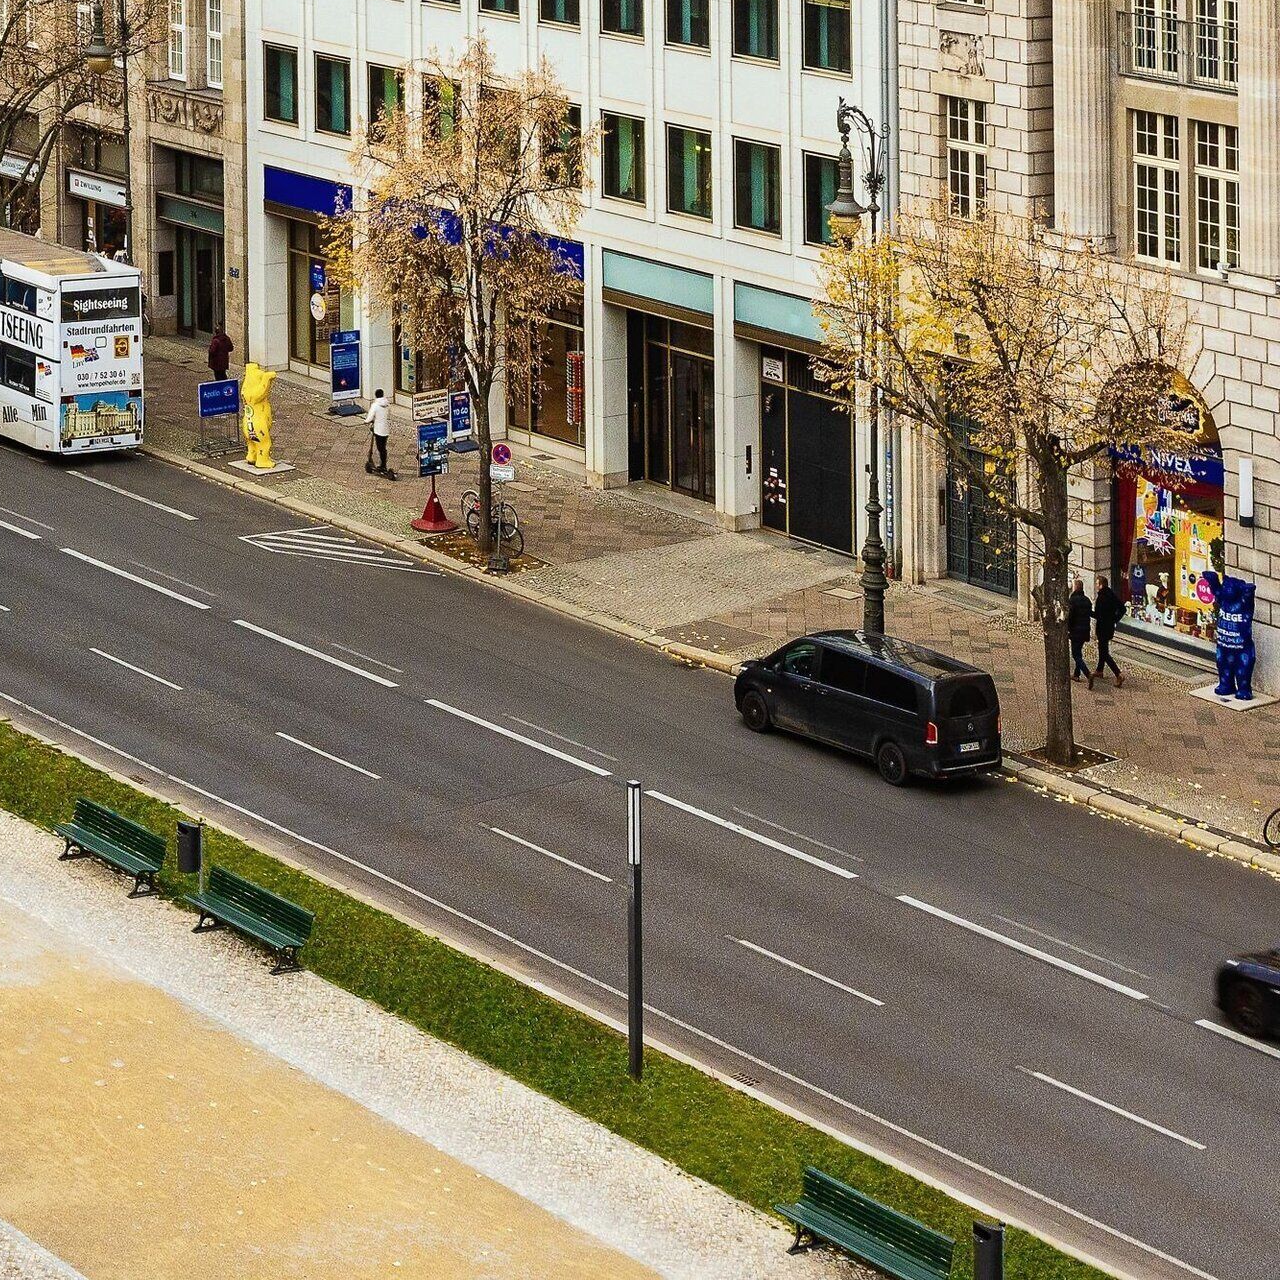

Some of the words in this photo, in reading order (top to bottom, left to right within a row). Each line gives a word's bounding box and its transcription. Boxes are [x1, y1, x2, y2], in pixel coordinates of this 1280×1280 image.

[73, 297, 128, 312] Sightseeing
[66, 322, 135, 337] Stadtrundfahrten
[72, 359, 85, 369] Liv
[76, 373, 90, 382] 030
[99, 371, 108, 380] 52
[109, 370, 118, 379] 30
[118, 369, 126, 378] 61
[77, 379, 126, 389] www.tempelhofer.de
[2, 405, 19, 424] Alle
[31, 404, 47, 421] Min
[453, 408, 460, 416] TO
[460, 406, 469, 415] GO
[1151, 449, 1193, 474] NIVEA
[1198, 584, 1206, 594] 10
